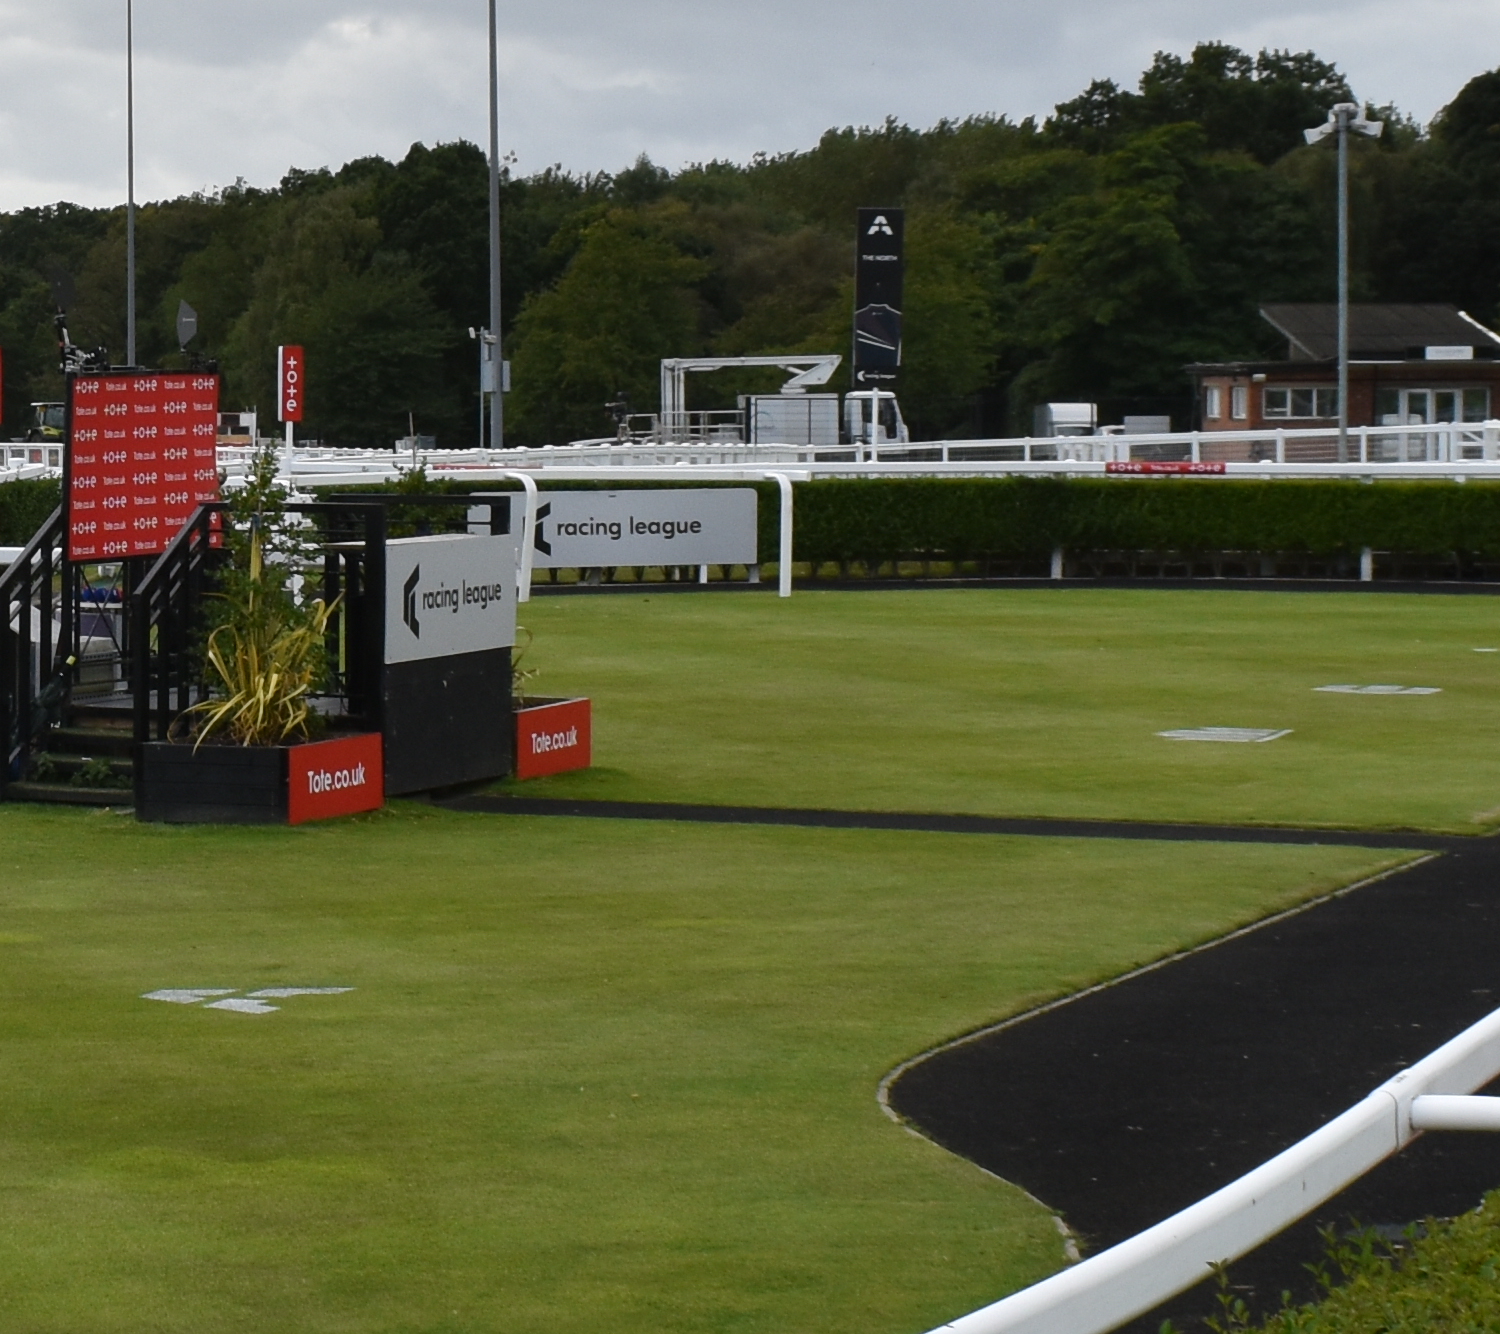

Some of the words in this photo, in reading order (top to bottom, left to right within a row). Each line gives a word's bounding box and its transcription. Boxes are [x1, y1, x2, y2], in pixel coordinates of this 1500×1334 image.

[557, 517, 621, 540] racing
[630, 515, 702, 539] league
[422, 582, 459, 613] racing
[462, 579, 502, 609] league
[532, 725, 577, 754] Tote.co.uk
[307, 761, 365, 794] Tote.co.uk
